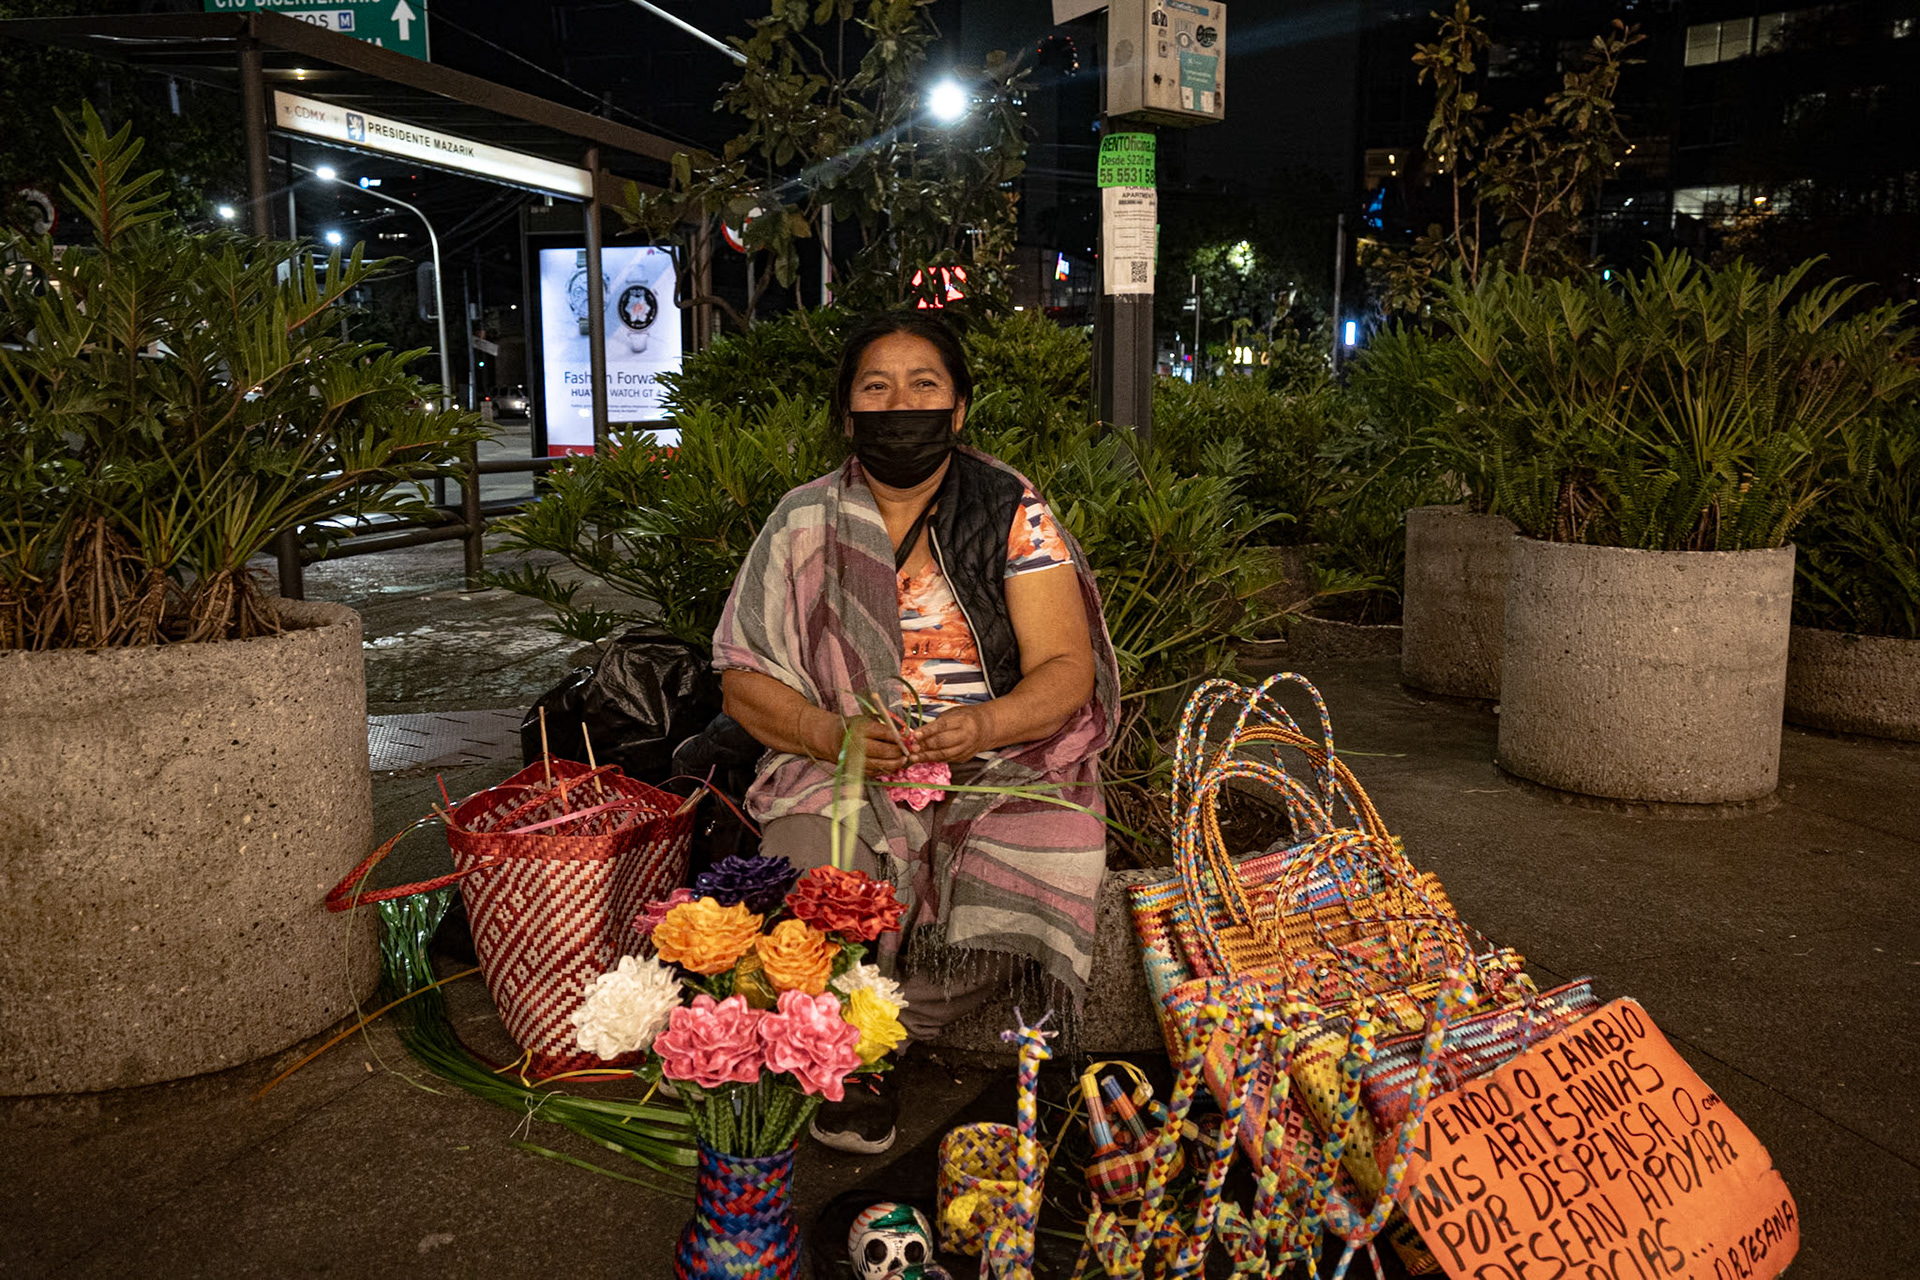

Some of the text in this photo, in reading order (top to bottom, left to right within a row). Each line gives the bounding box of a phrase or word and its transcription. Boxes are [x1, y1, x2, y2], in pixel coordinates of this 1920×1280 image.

[294, 105, 325, 123] CDMX
[368, 121, 475, 158] PRESIDENTE MAZARIK
[1099, 168, 1113, 183] 55
[1117, 167, 1142, 183] 5531
[1101, 155, 1125, 166] Desde
[610, 389, 640, 398] WATCH
[643, 389, 653, 398] GT
[1413, 1005, 1646, 1162] VENDO O CAMBIO
[1409, 1049, 1665, 1232] MIS ARTESANIAS
[1437, 1193, 1521, 1272] POR
[1519, 1102, 1674, 1222] DESPENSA
[1672, 1087, 1700, 1127] O
[1627, 1119, 1738, 1221] APOYAR
